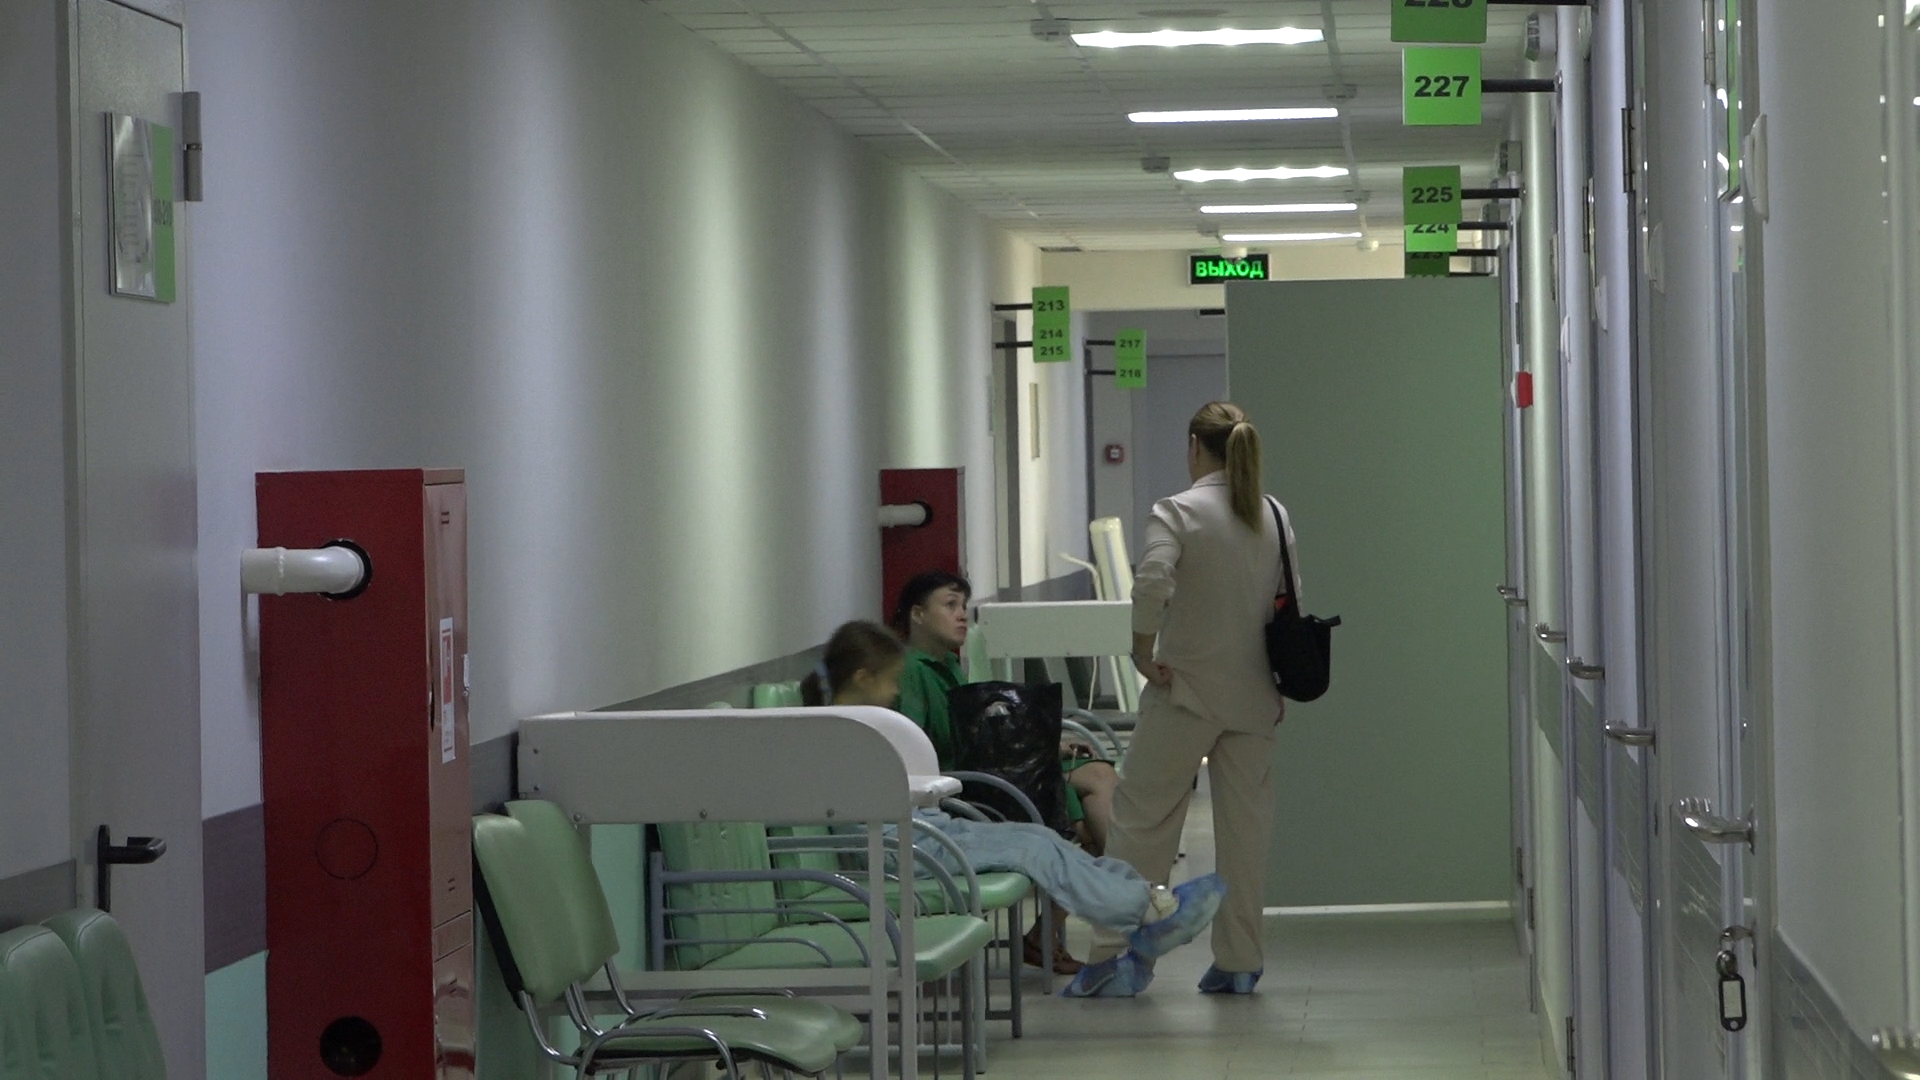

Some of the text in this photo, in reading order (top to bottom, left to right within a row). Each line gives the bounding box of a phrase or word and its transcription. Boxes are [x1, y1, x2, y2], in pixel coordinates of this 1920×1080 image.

[1414, 75, 1470, 98] 227
[1411, 186, 1453, 204] 225
[1195, 260, 1265, 279] ВЫХОД
[1037, 300, 1065, 311] 213
[1039, 328, 1063, 339] 214
[1119, 338, 1141, 349] 217
[1040, 345, 1064, 356] 215
